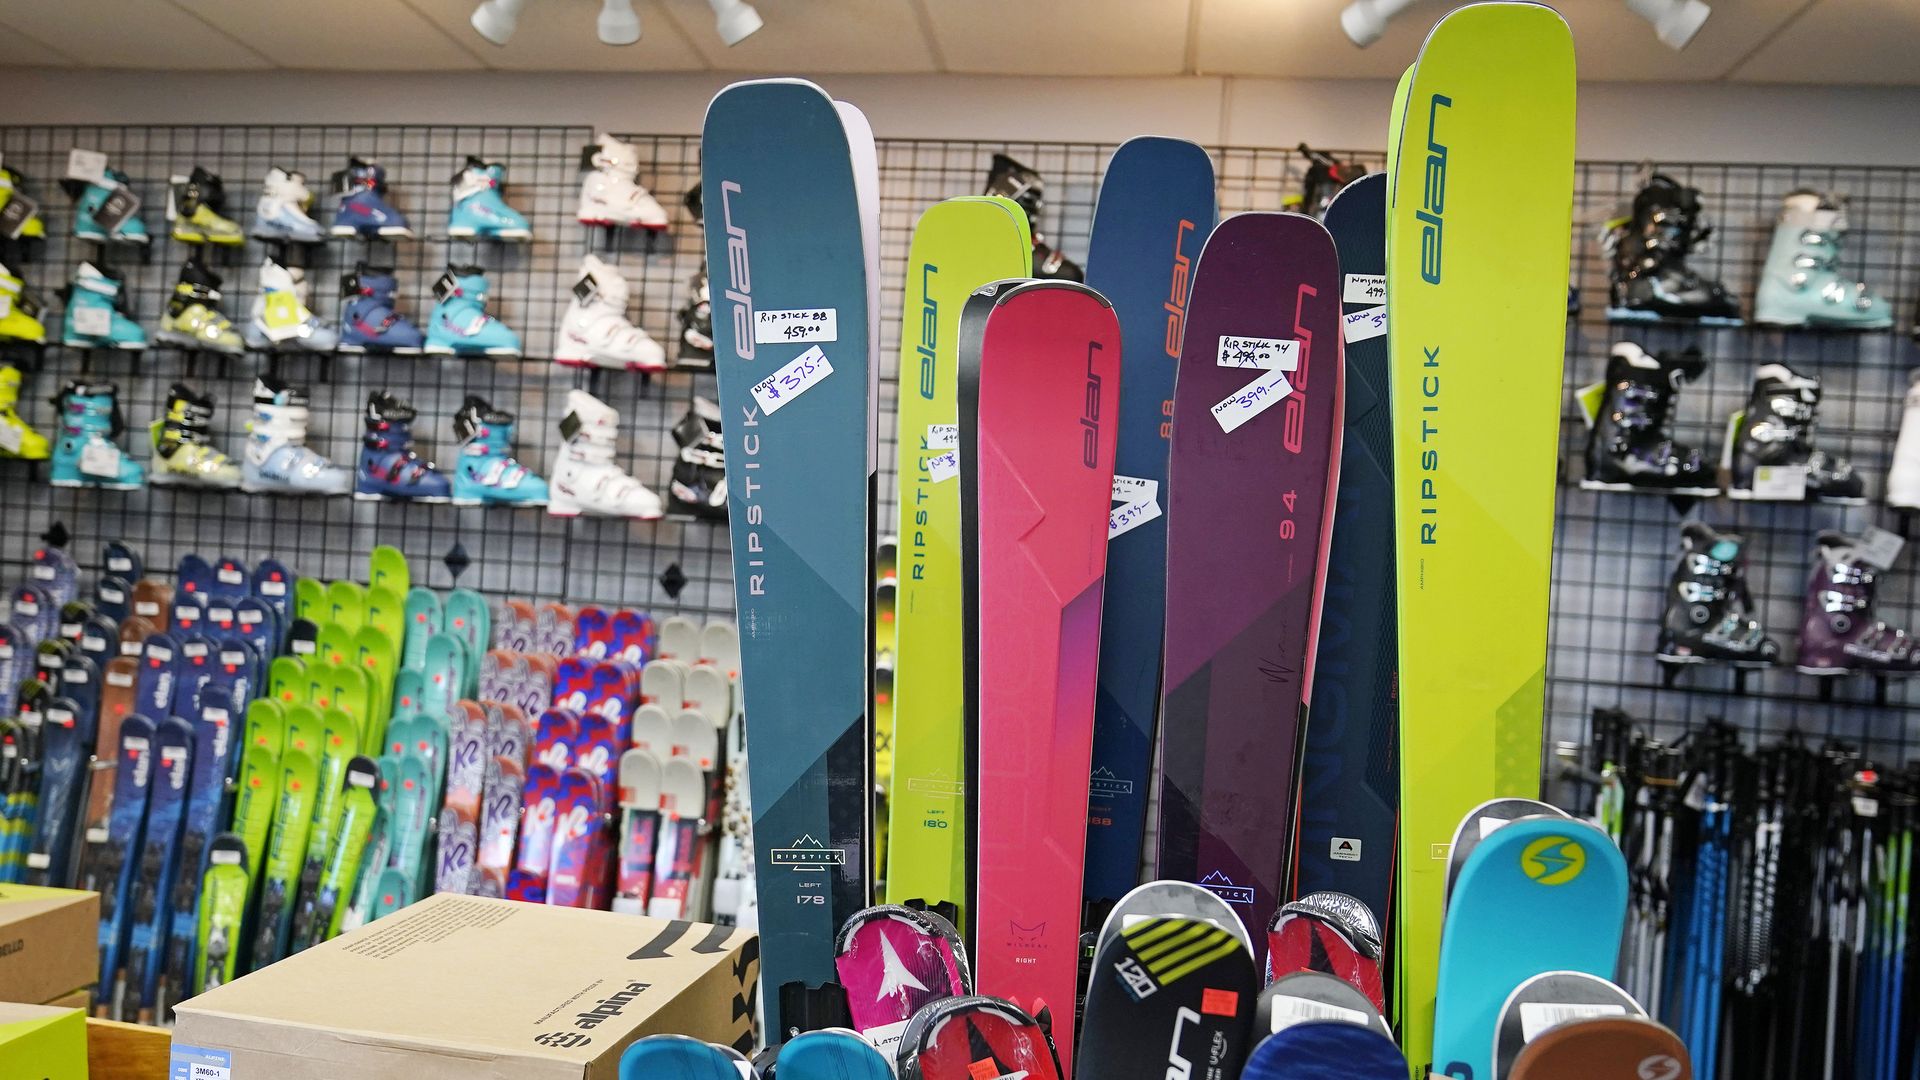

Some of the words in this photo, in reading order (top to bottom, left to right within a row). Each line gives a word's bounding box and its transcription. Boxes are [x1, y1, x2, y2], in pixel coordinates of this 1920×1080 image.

[1416, 93, 1452, 286] elan
[721, 180, 755, 361] elan
[1163, 219, 1195, 359] elan
[917, 263, 938, 401] elan
[1274, 343, 1290, 354] 94
[1284, 283, 1317, 454] elan
[754, 374, 776, 394] NOW
[1080, 340, 1103, 470] elan
[1215, 395, 1236, 414] NOW
[1421, 345, 1440, 545] RIPSTICK
[743, 405, 765, 597] RIPSTICK
[912, 435, 929, 580] RIPSTICK
[1279, 489, 1297, 540] 94
[776, 853, 840, 861] RIPSTICK
[795, 894, 825, 905] 178
[574, 982, 653, 1030] alpina
[1113, 956, 1158, 999] 120
[195, 1066, 220, 1077] 3M60-1
